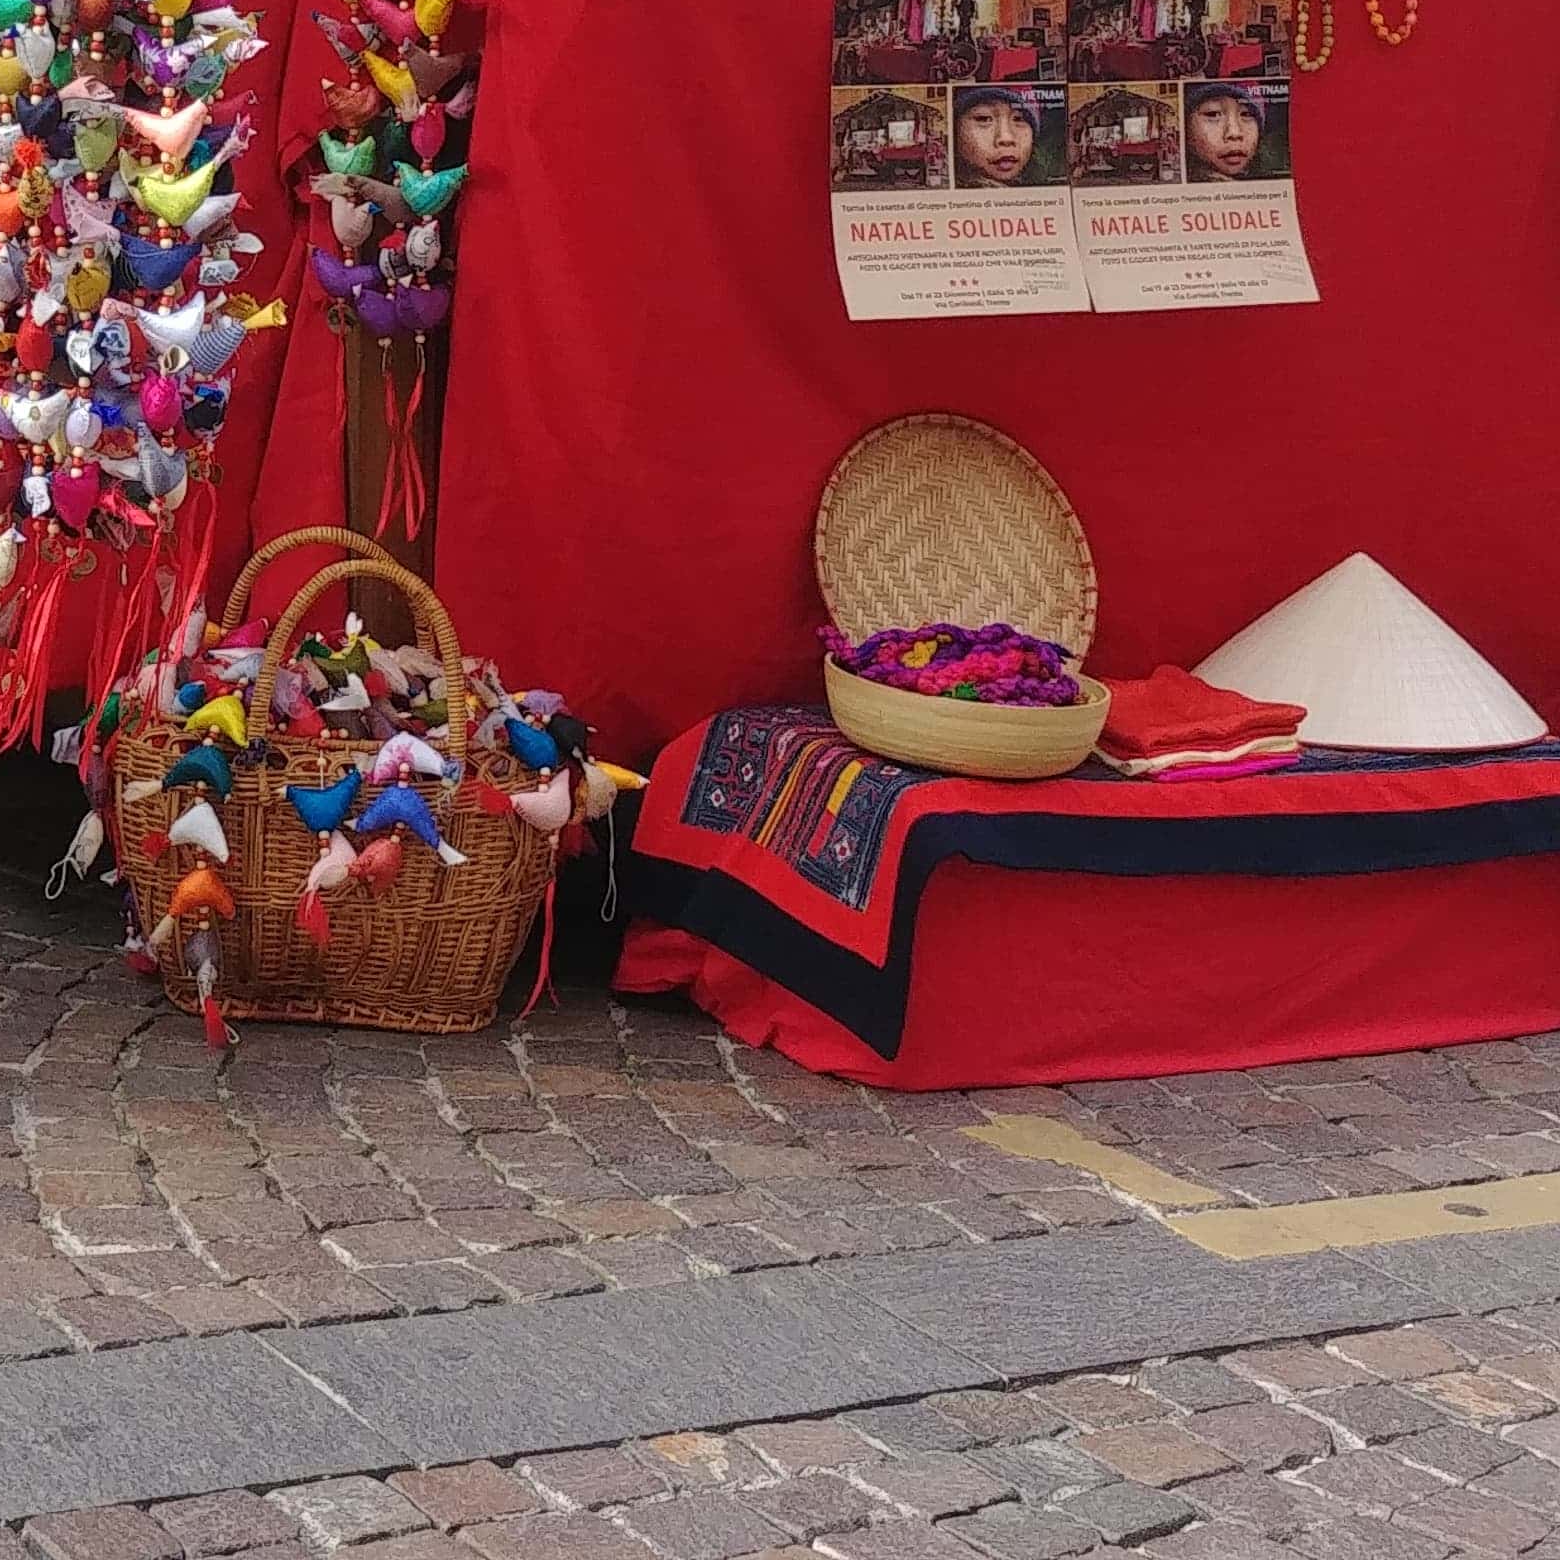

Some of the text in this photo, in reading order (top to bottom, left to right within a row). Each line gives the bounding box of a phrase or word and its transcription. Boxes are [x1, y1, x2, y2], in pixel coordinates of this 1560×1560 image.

[1021, 89, 1065, 100] VIETNAM
[1247, 85, 1289, 96] VIETNAM
[850, 216, 1058, 242] NATALE SOLIDALE
[1091, 209, 1282, 237] NATALE SOLIDALE
